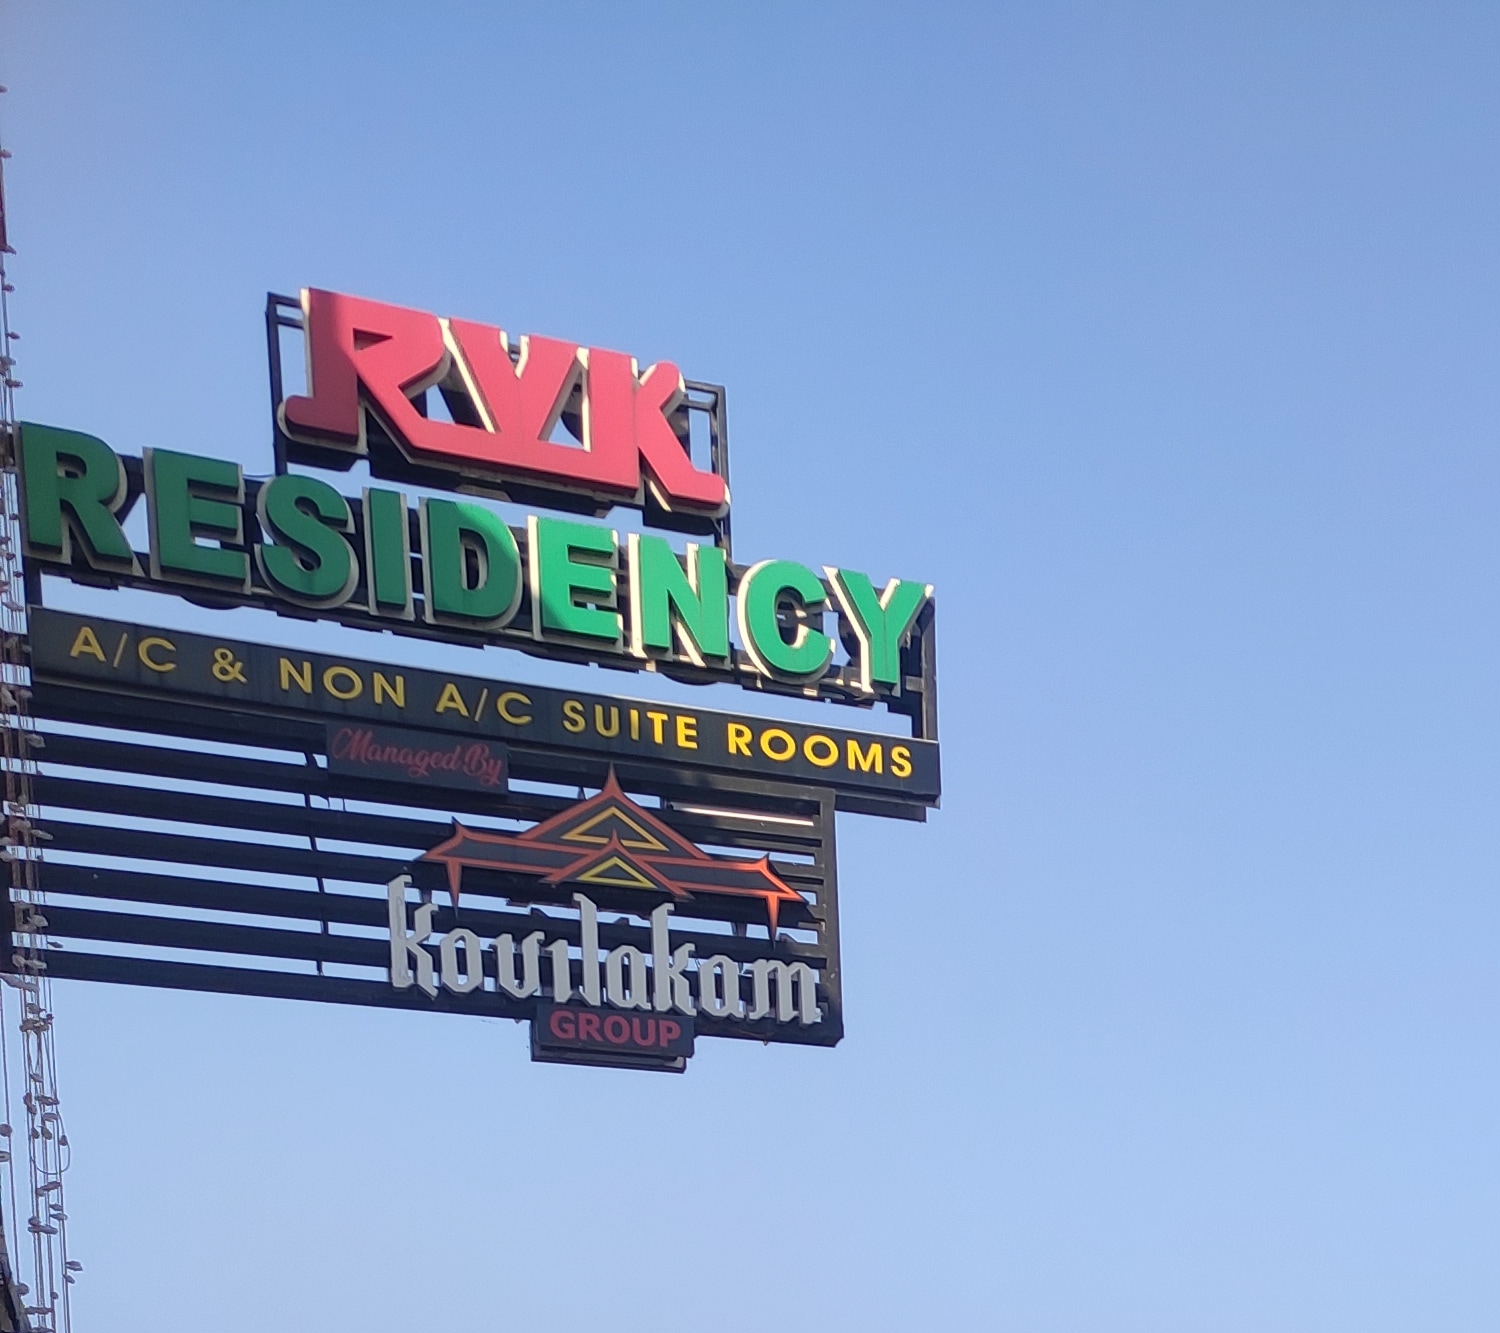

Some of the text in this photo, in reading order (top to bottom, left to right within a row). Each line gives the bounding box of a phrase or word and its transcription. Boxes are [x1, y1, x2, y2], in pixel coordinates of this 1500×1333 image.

[17, 420, 934, 694] RESIDENCY
[70, 627, 913, 780] A/C & NON A/C SUITE ROOMS
[331, 727, 502, 785] Managed By
[549, 1010, 681, 1047] GROUP
